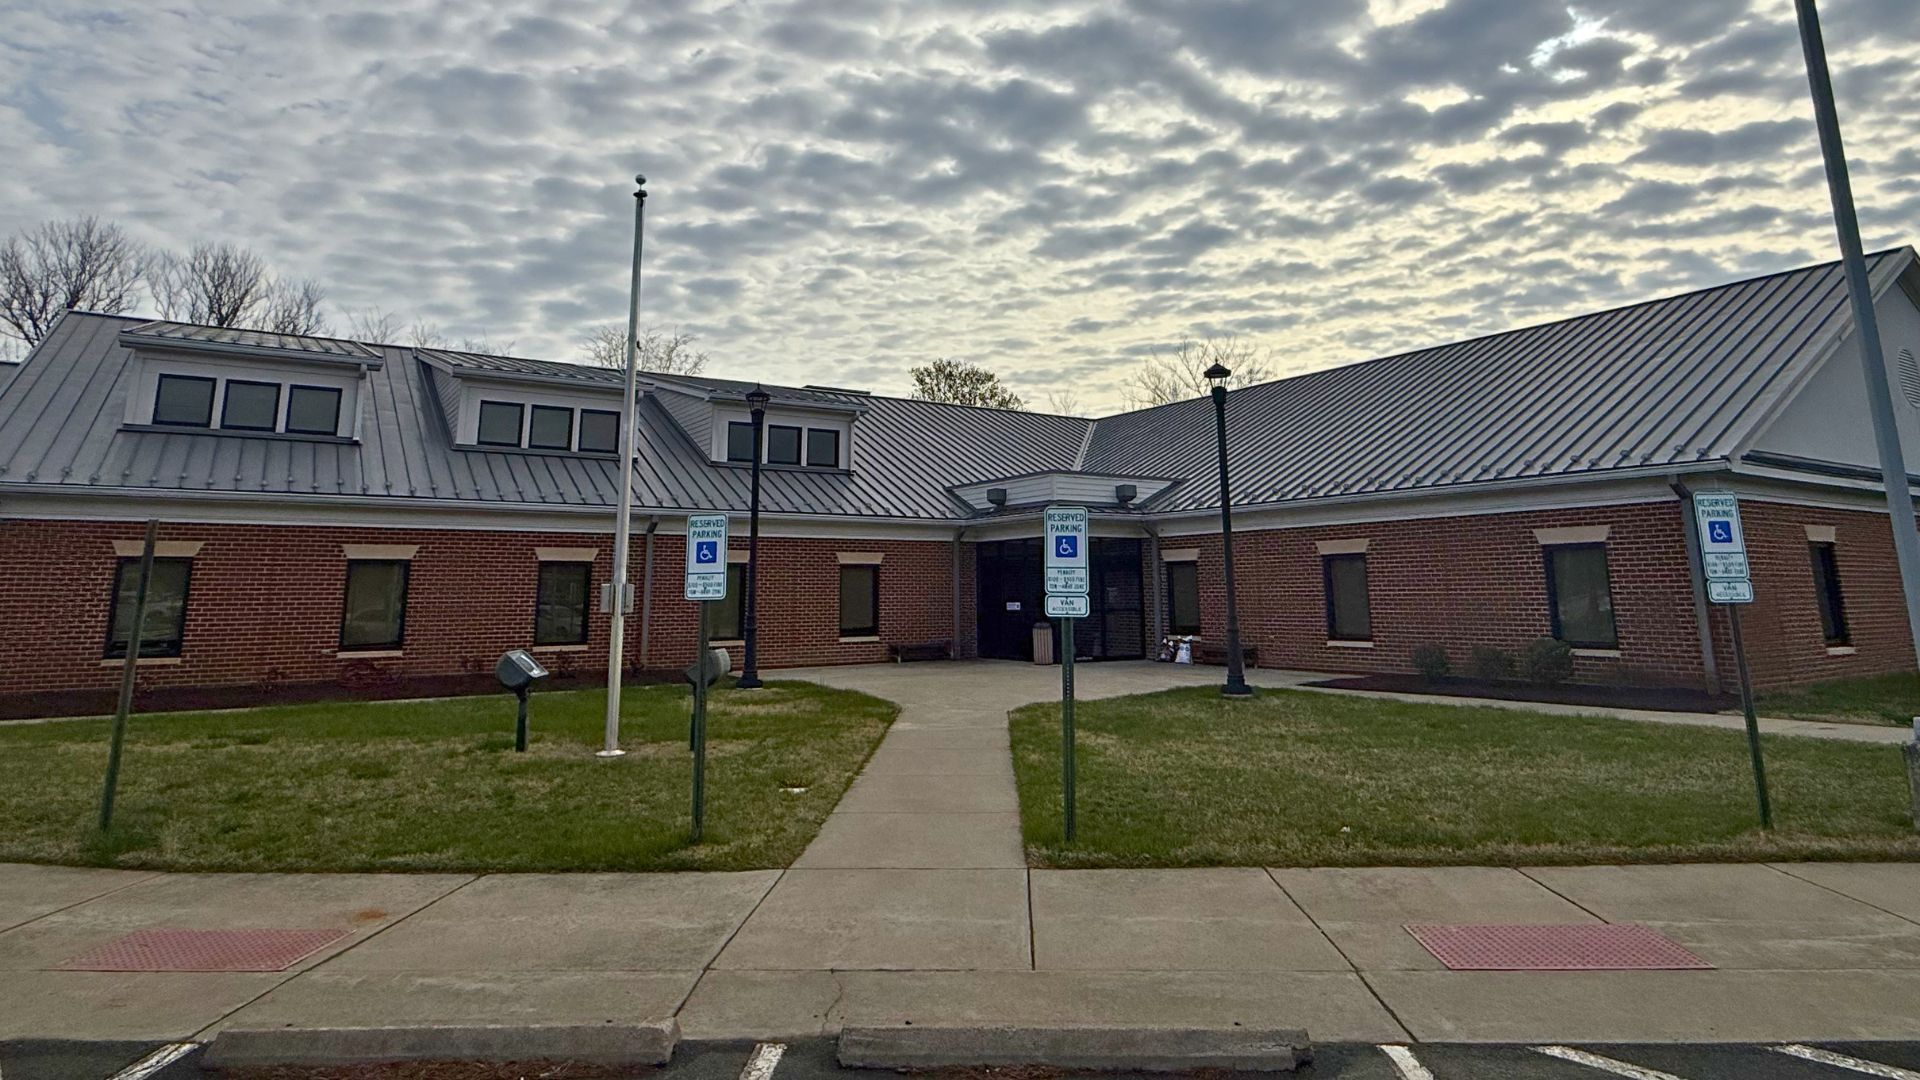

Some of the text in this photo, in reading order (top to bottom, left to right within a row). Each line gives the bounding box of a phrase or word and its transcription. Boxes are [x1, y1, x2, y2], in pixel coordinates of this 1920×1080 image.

[1048, 513, 1085, 521] RESERVED
[1701, 510, 1734, 518] PARKING
[690, 520, 725, 528] RESERVED
[1050, 524, 1082, 532] PARKING
[692, 530, 722, 538] PARKING
